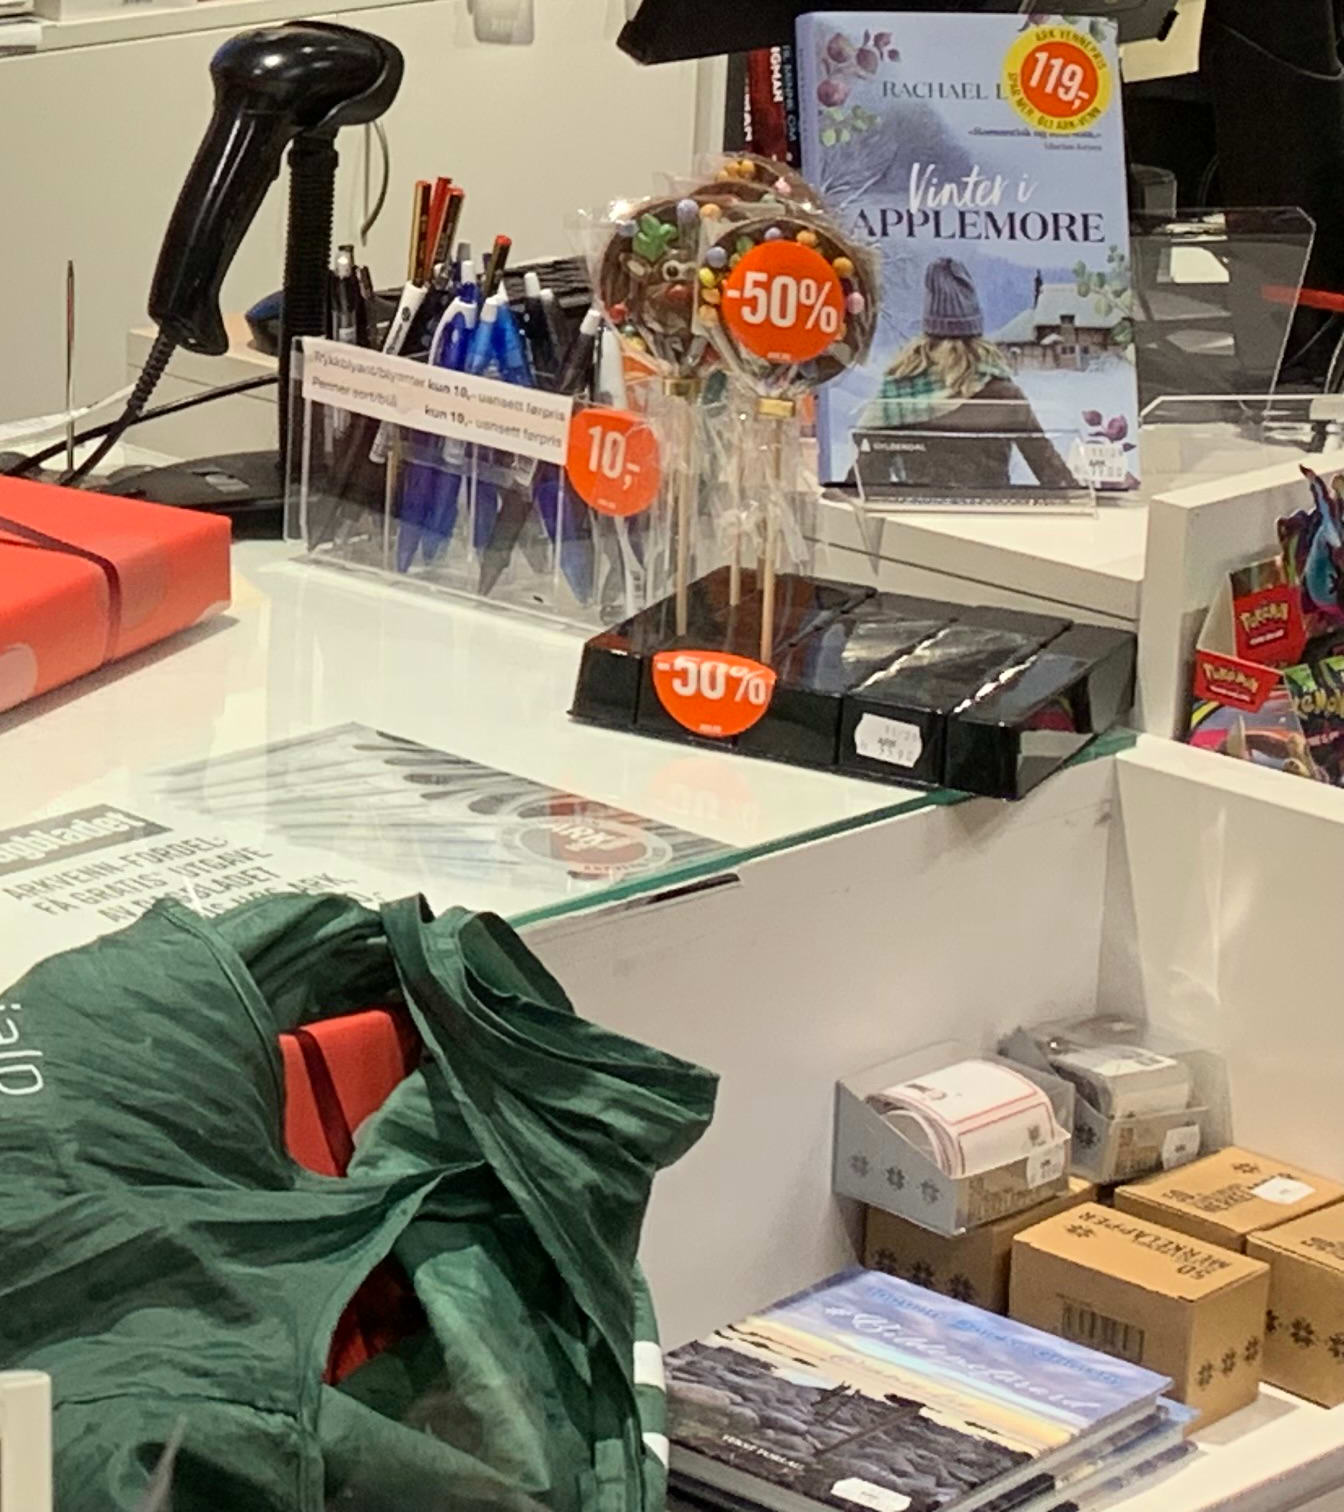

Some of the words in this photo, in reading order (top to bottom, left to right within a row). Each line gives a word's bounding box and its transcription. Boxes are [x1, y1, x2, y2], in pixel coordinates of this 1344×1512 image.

[881, 80, 989, 100] RACHAEL
[1029, 51, 1090, 112] 119,-
[908, 162, 1008, 218] Vinter
[851, 207, 1107, 244] APPLEMORE
[727, 271, 839, 334] -50%
[428, 378, 450, 395] kun
[479, 391, 524, 412] uansett
[425, 404, 448, 420] kun
[475, 419, 521, 439] uansett
[587, 424, 640, 491] 10,-
[657, 657, 769, 706] -50%
[169, 845, 274, 879] UTGAVE
